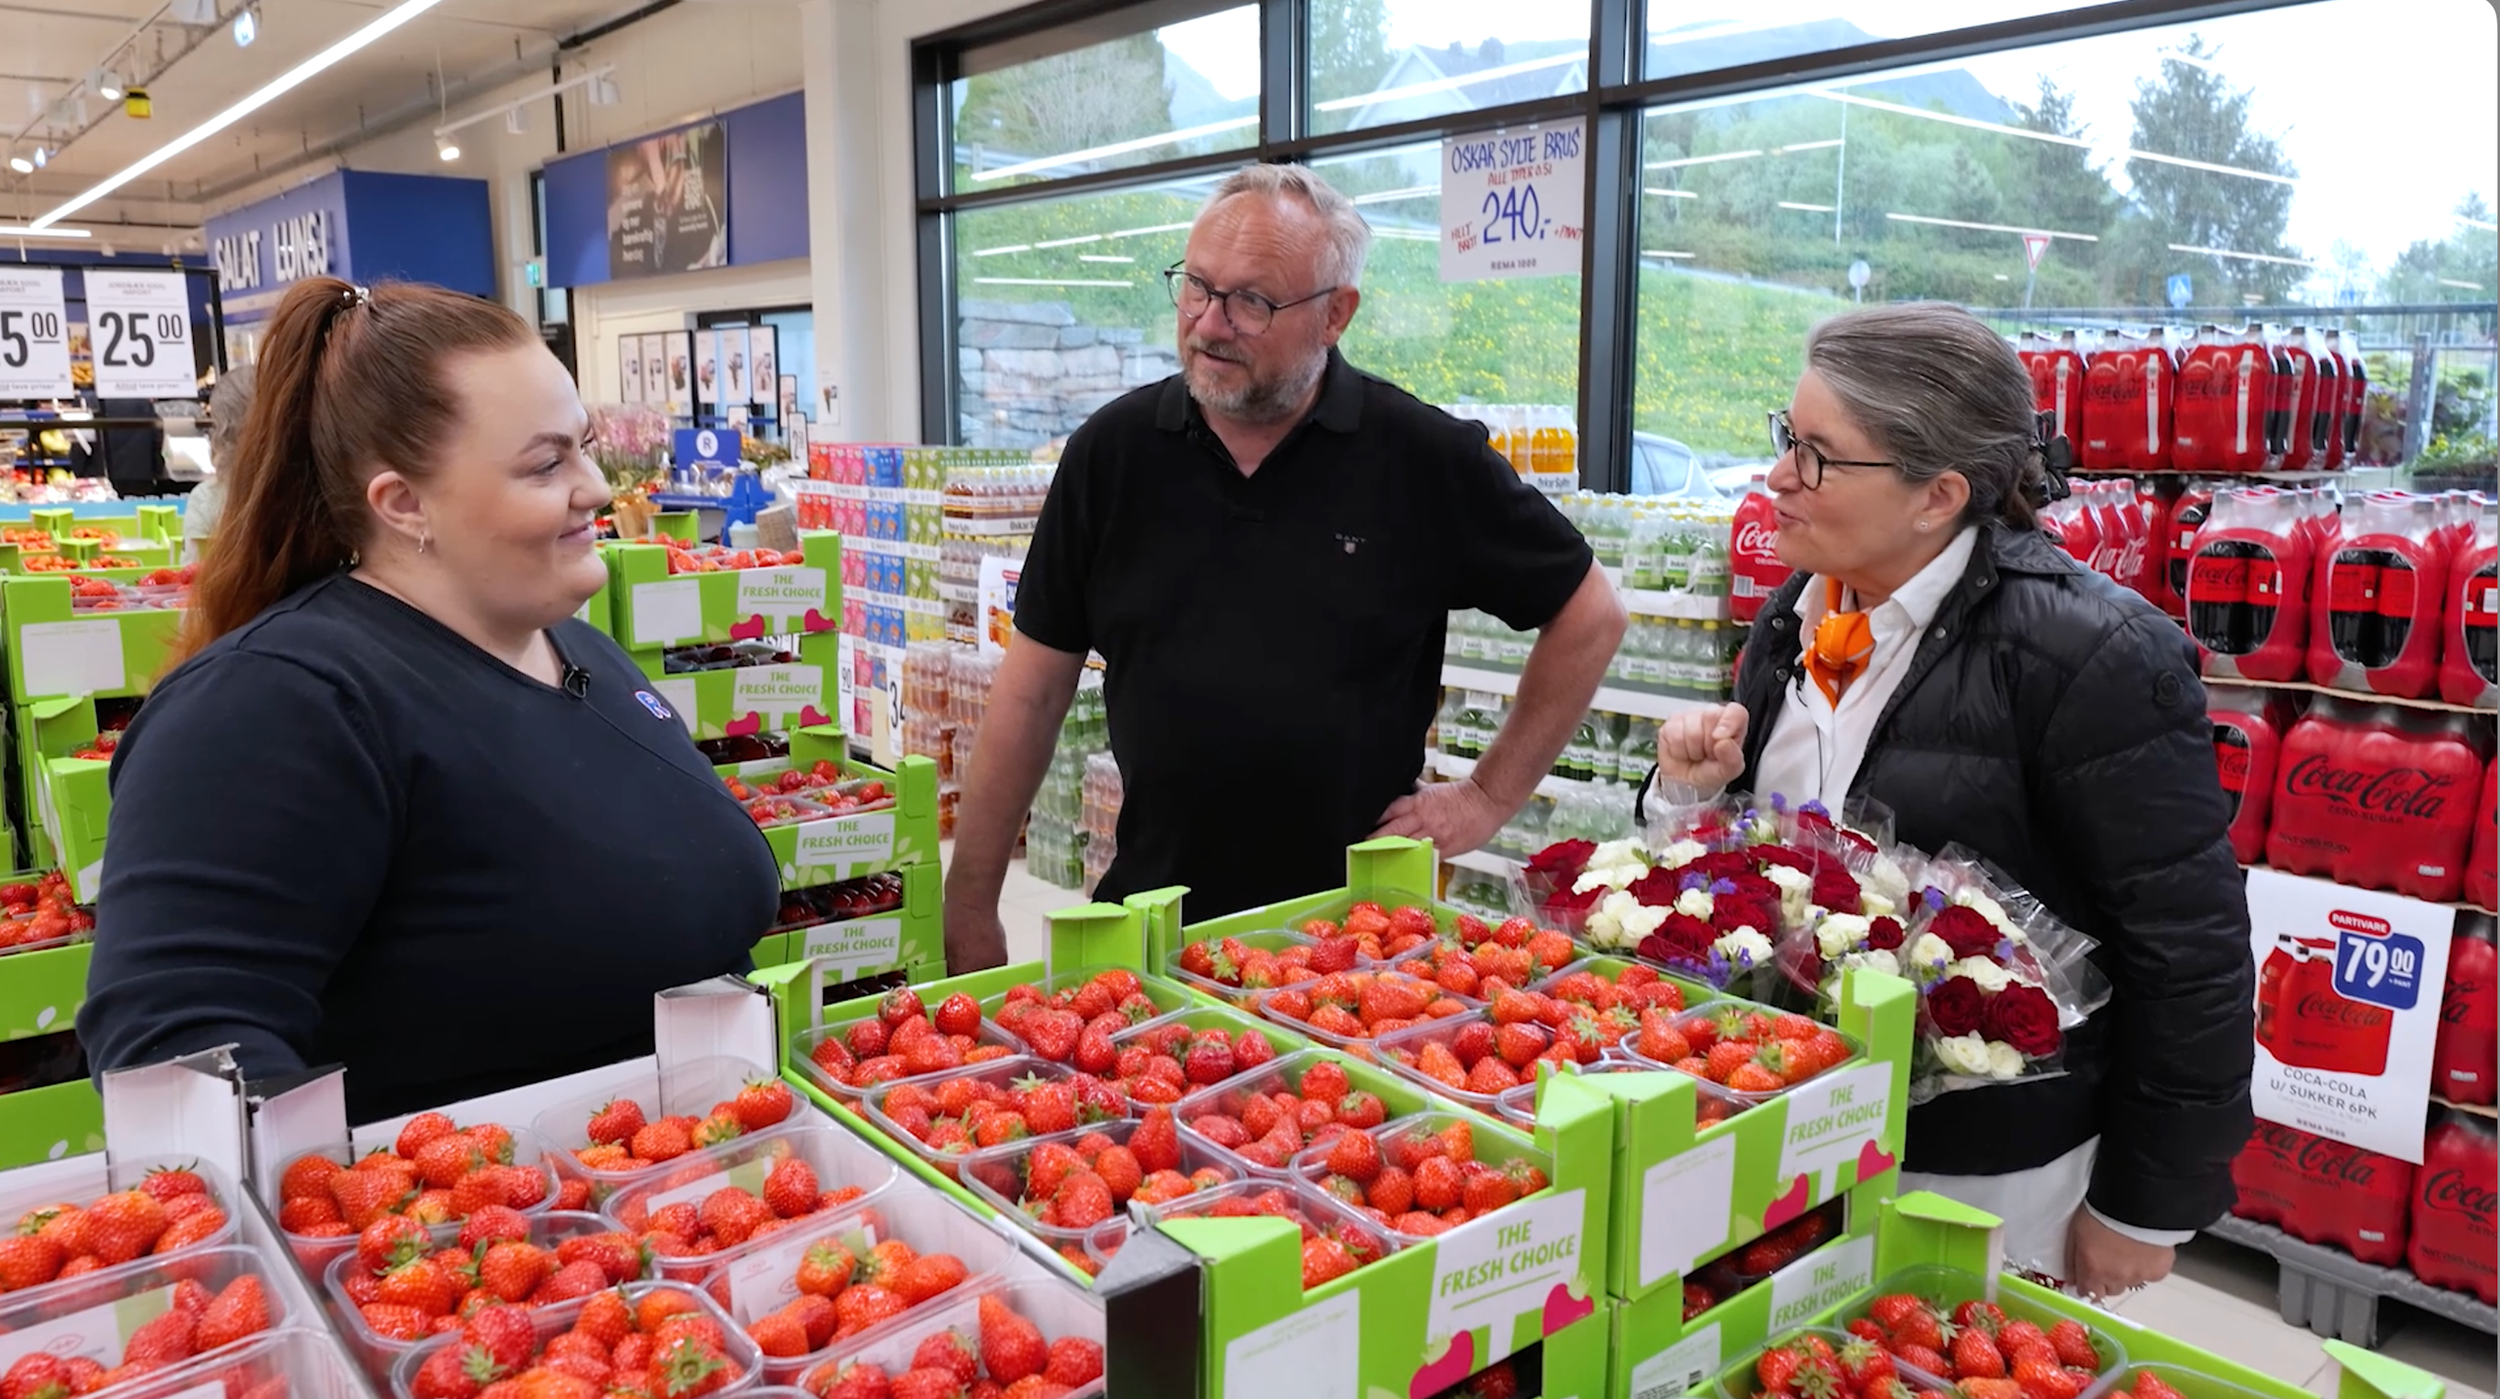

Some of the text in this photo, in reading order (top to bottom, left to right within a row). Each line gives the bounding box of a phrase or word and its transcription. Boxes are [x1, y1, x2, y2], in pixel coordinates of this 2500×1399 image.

[1452, 126, 1581, 174] OSKAR SYLTE BRUS
[1488, 171, 1506, 186] ALLE
[215, 209, 328, 293] SALAT LUNSJ
[1490, 258, 1537, 271] REMA 1000
[0, 311, 58, 368] 5 00
[99, 311, 183, 367] 25 00
[702, 437, 712, 450] R
[1335, 533, 1367, 544] GANT
[773, 574, 794, 585] THE
[743, 587, 822, 598] FRESH CHOICE
[770, 672, 790, 682] THE
[739, 684, 818, 695] FRESH CHOICE
[2286, 754, 2451, 820] Coca-Cola
[2327, 804, 2404, 825] ZERO SUGAR
[836, 821, 860, 832] THE
[802, 833, 890, 849] FRESH CHOICE
[843, 926, 866, 938] THE
[2331, 913, 2388, 934] PARTIVARE
[809, 937, 896, 955] FRESH CHOICE
[2344, 936, 2415, 989] 79 00
[2297, 991, 2384, 1027] Coca-Cola
[2283, 1066, 2368, 1100] COCA-COLA
[1829, 1084, 1854, 1108] THE
[2270, 1078, 2286, 1092] U/
[2289, 1083, 2346, 1110] SUKKER
[2349, 1103, 2378, 1120] 6PK
[1789, 1100, 1884, 1145] FRESH CHOICE
[2296, 1118, 2346, 1138] REMA 1000
[1497, 1219, 1533, 1249] THE
[1440, 1233, 1576, 1298] FRESH CHOICE
[1813, 1262, 1836, 1286] THE
[1774, 1273, 1868, 1326] FRESH CHOICE
